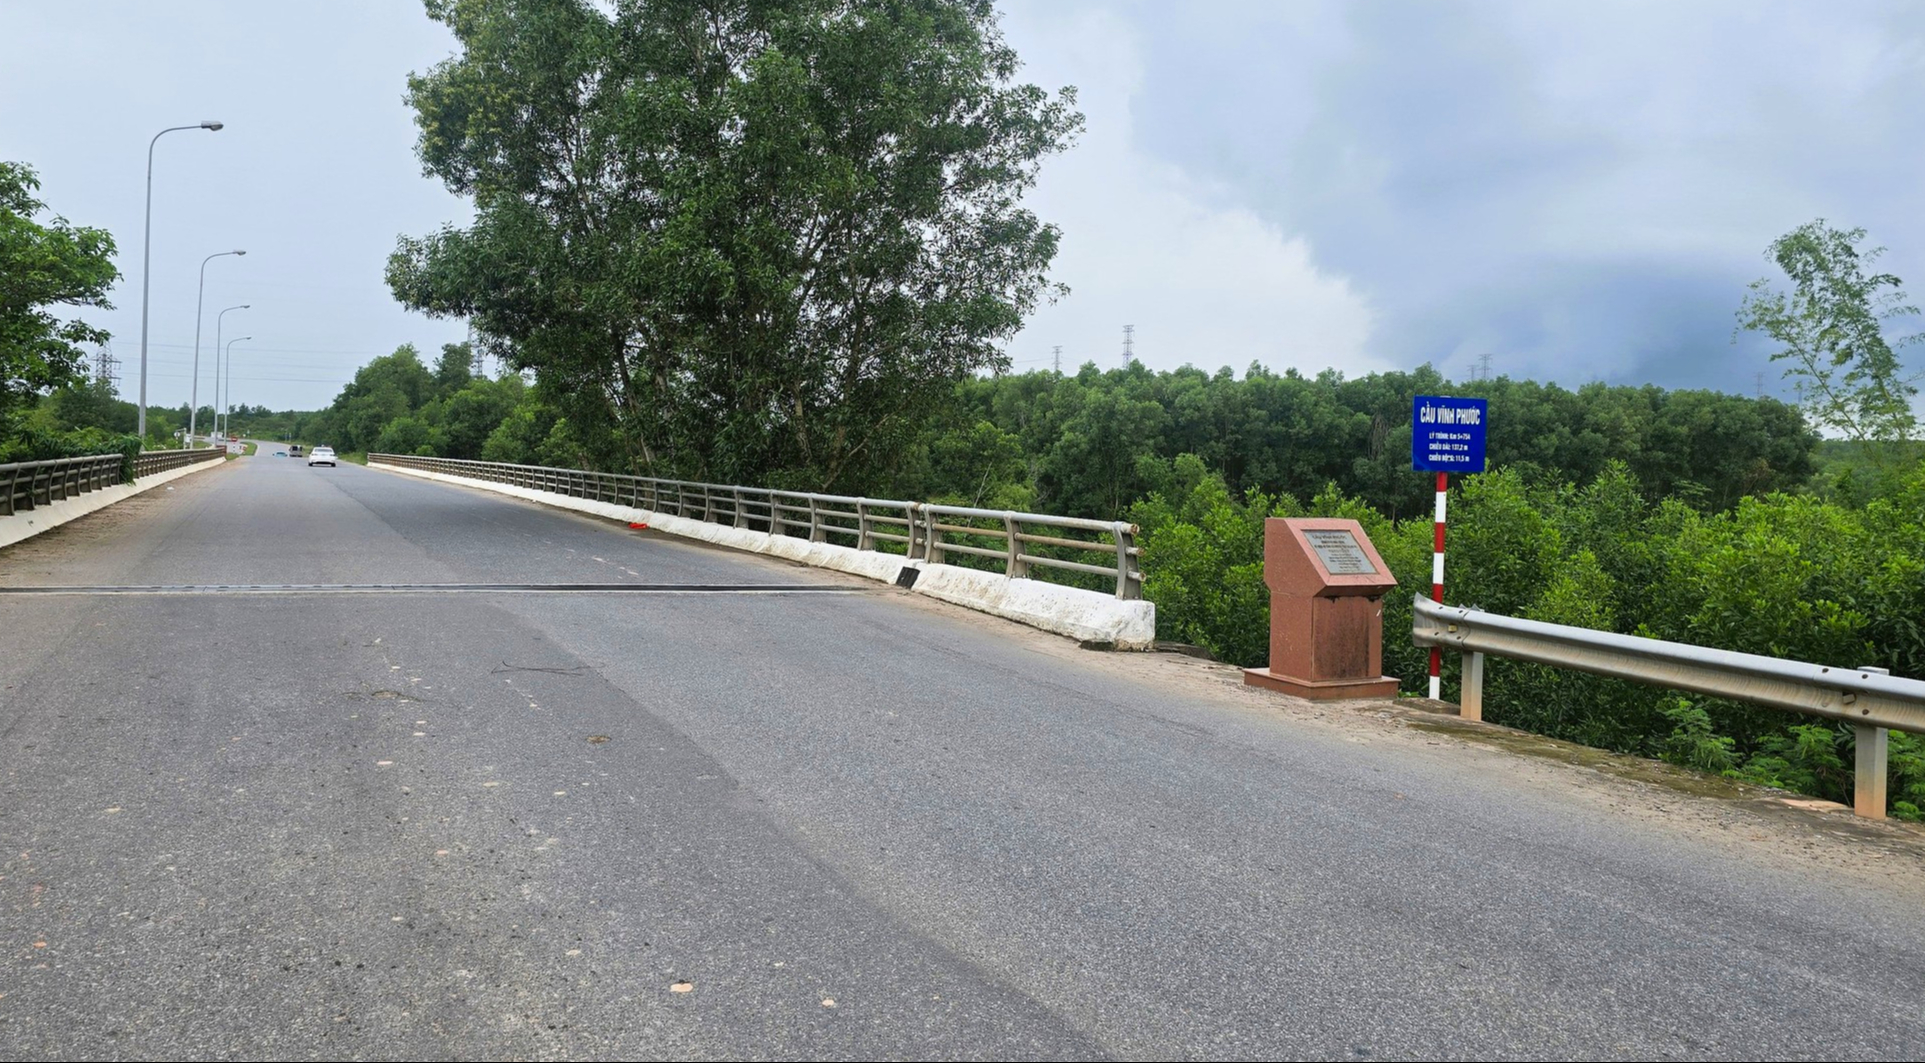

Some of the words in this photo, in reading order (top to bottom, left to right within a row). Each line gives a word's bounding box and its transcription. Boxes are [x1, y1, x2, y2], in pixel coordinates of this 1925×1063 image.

[1420, 401, 1436, 424] CẦU
[1437, 405, 1455, 424] VĨNH
[1456, 406, 1481, 425] PHƯỚC
